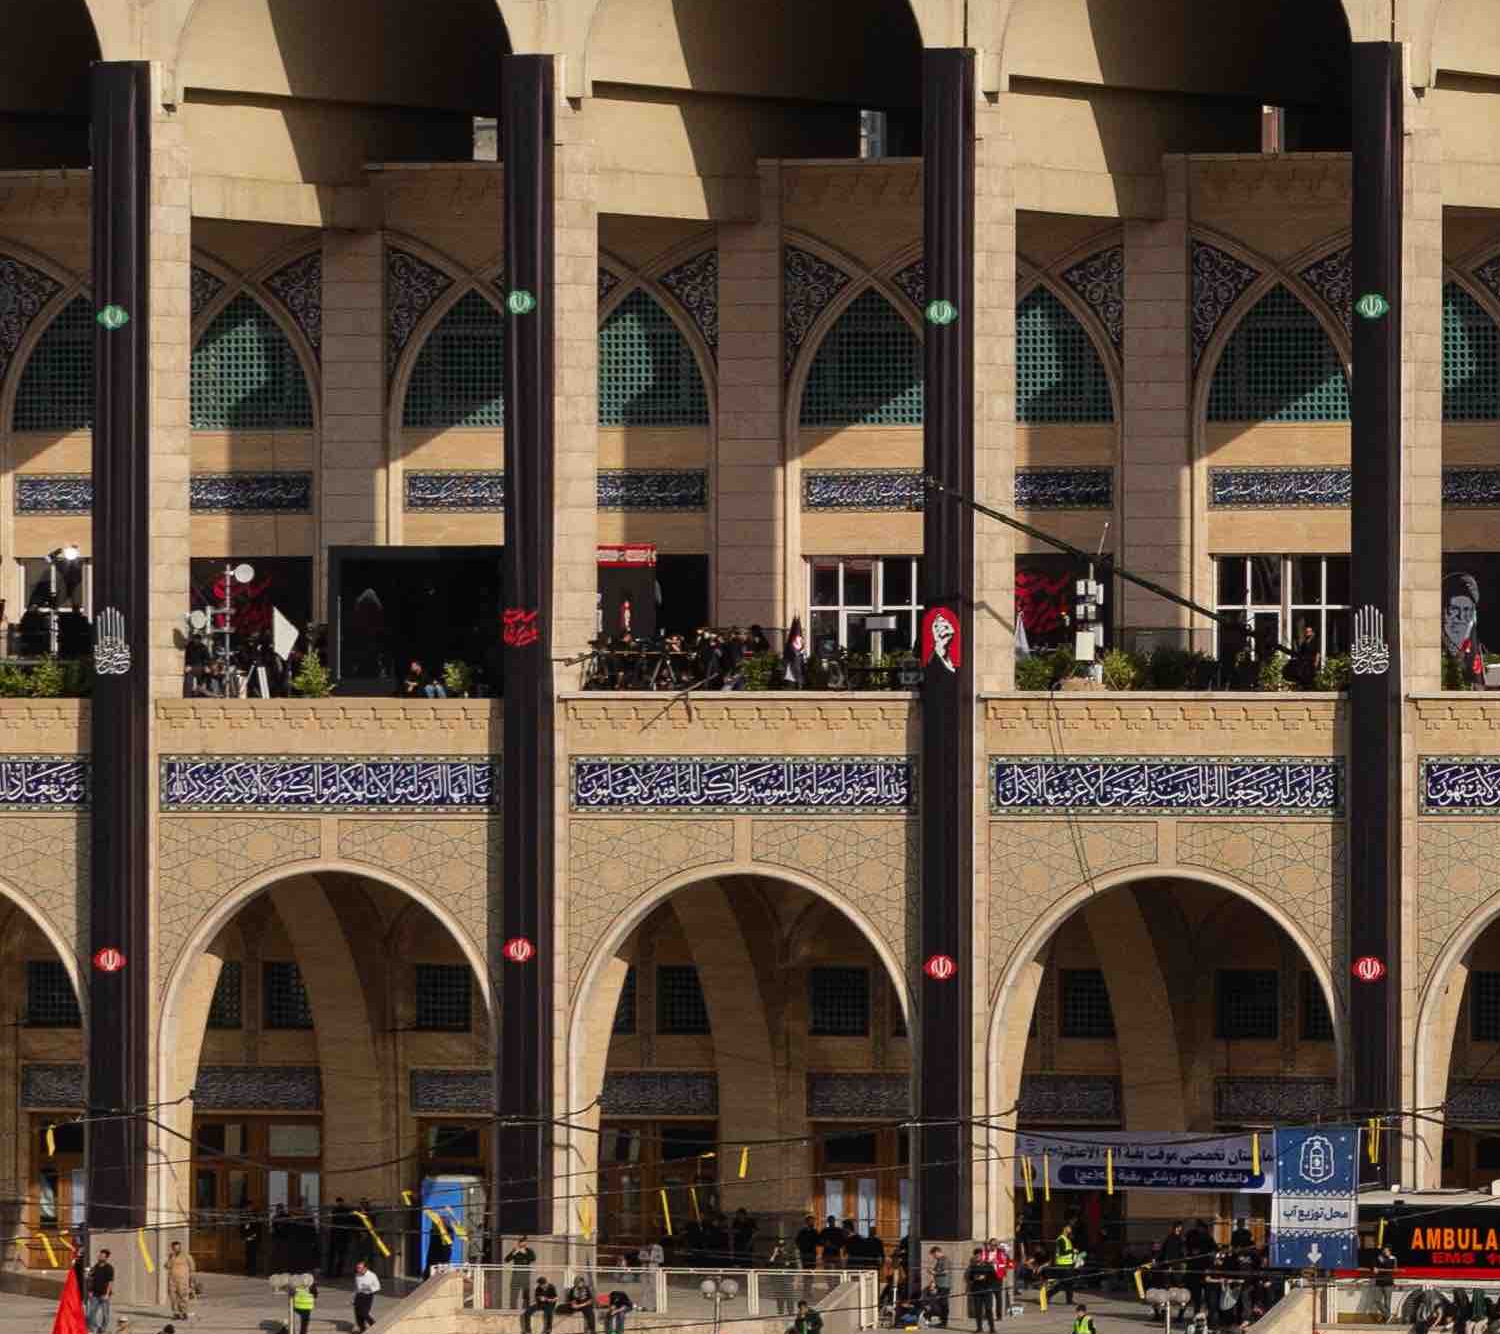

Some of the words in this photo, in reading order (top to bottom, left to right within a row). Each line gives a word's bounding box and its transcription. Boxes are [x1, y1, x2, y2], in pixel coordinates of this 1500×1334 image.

[1282, 1204, 1298, 1220] آب
[1297, 1207, 1325, 1222] توزیع
[1324, 1207, 1349, 1221] محل
[1431, 1252, 1474, 1265] EMS
